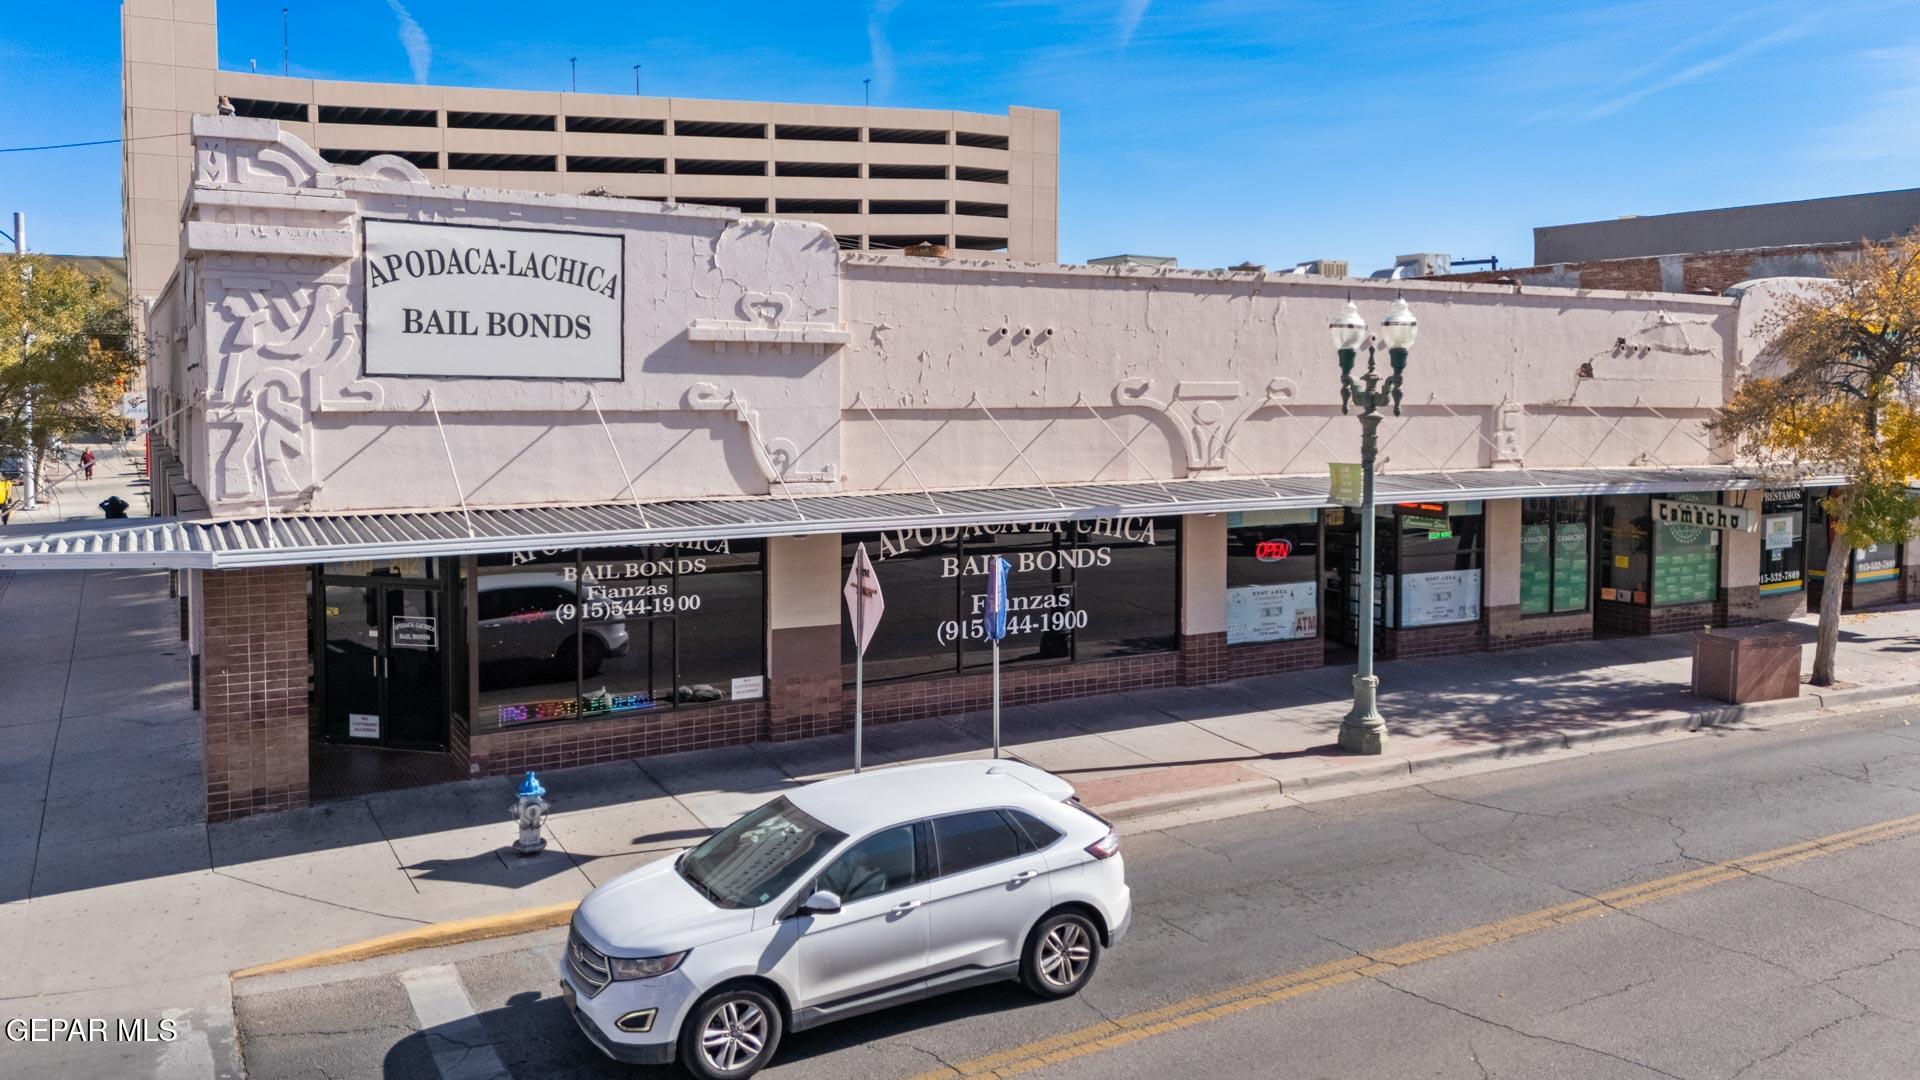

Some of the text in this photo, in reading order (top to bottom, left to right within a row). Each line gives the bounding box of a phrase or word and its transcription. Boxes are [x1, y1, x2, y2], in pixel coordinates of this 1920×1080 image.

[369, 248, 618, 300] APODACA-LACHICA
[402, 308, 591, 340] BAIL BONDS
[941, 547, 1111, 578] BAI BONDS
[1256, 541, 1290, 560] OPEN
[563, 558, 707, 582] BAIL BONDS
[586, 583, 668, 600] Fianzas
[971, 593, 1071, 615] Fnzas
[937, 609, 1088, 646] (91544-1900
[1296, 616, 1316, 632] ATM
